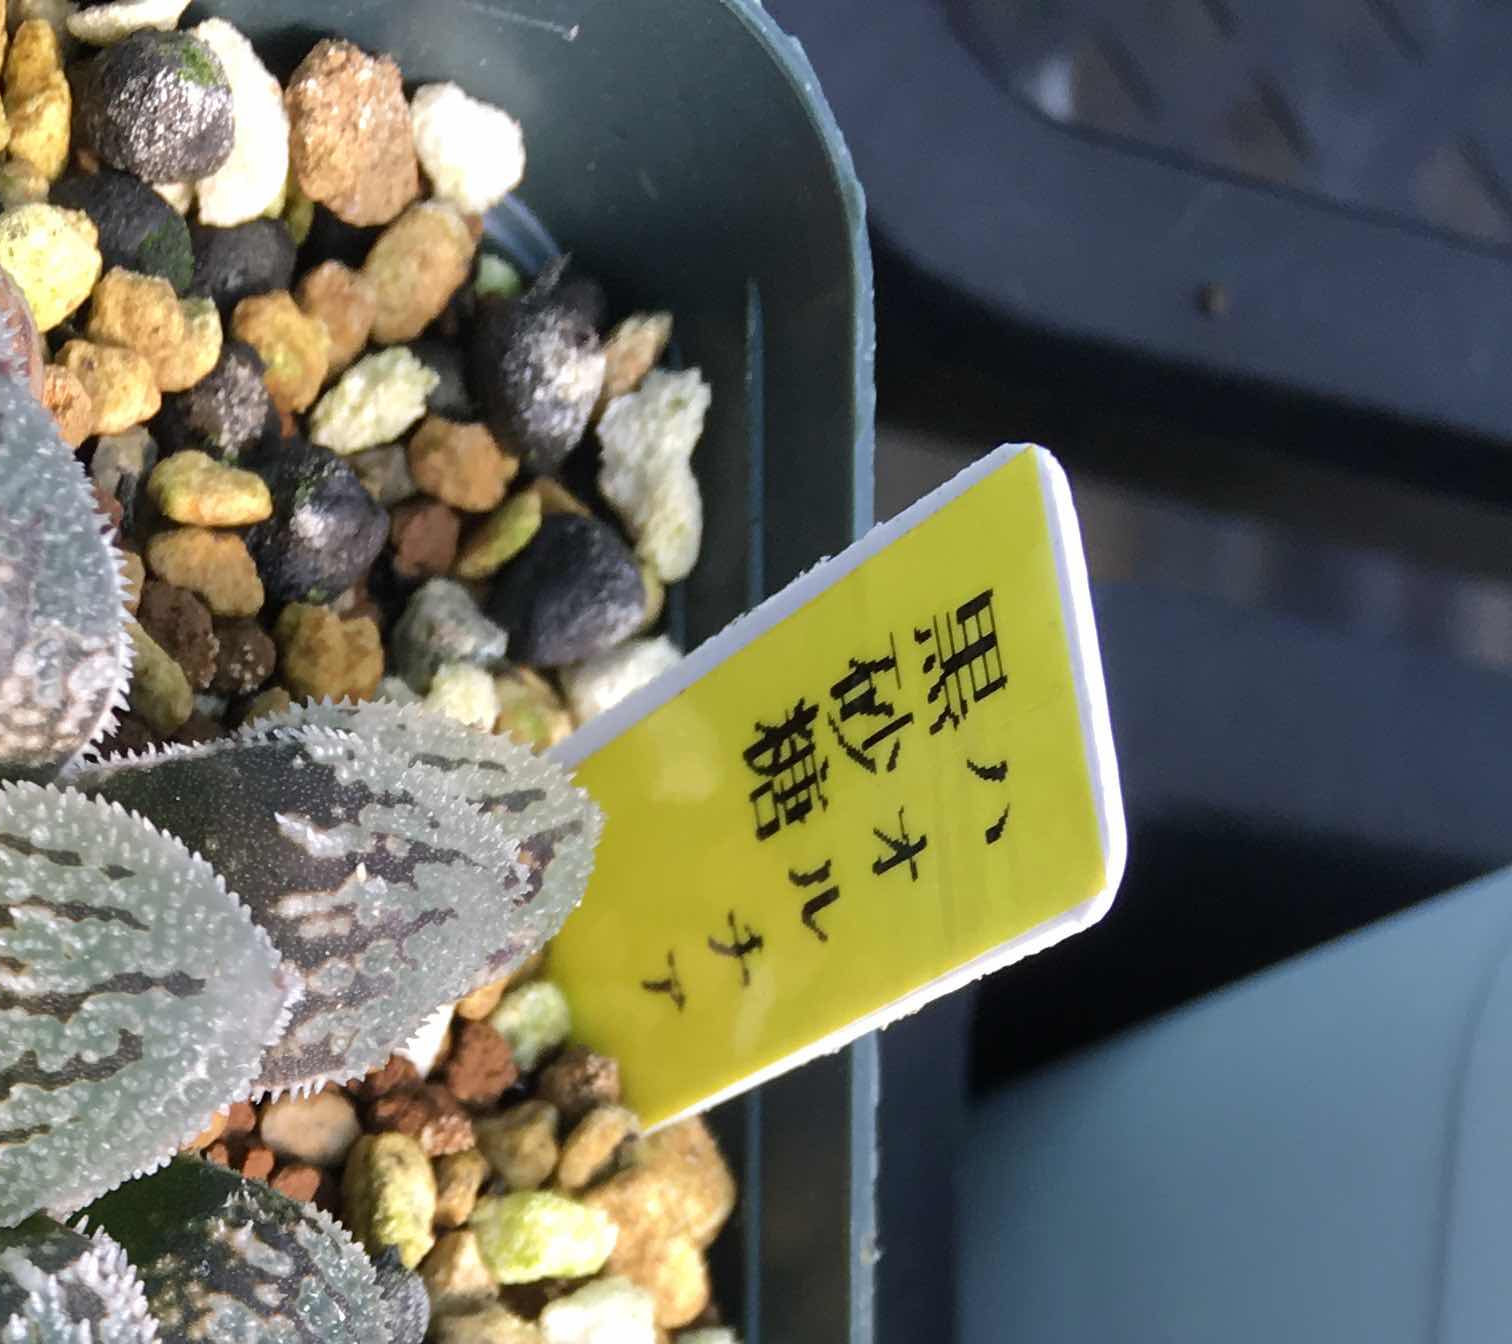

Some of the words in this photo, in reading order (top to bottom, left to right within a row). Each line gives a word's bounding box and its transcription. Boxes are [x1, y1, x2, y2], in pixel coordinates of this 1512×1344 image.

[742, 588, 1009, 842] 黒砂糖
[642, 759, 1011, 1013] ハオルチア
